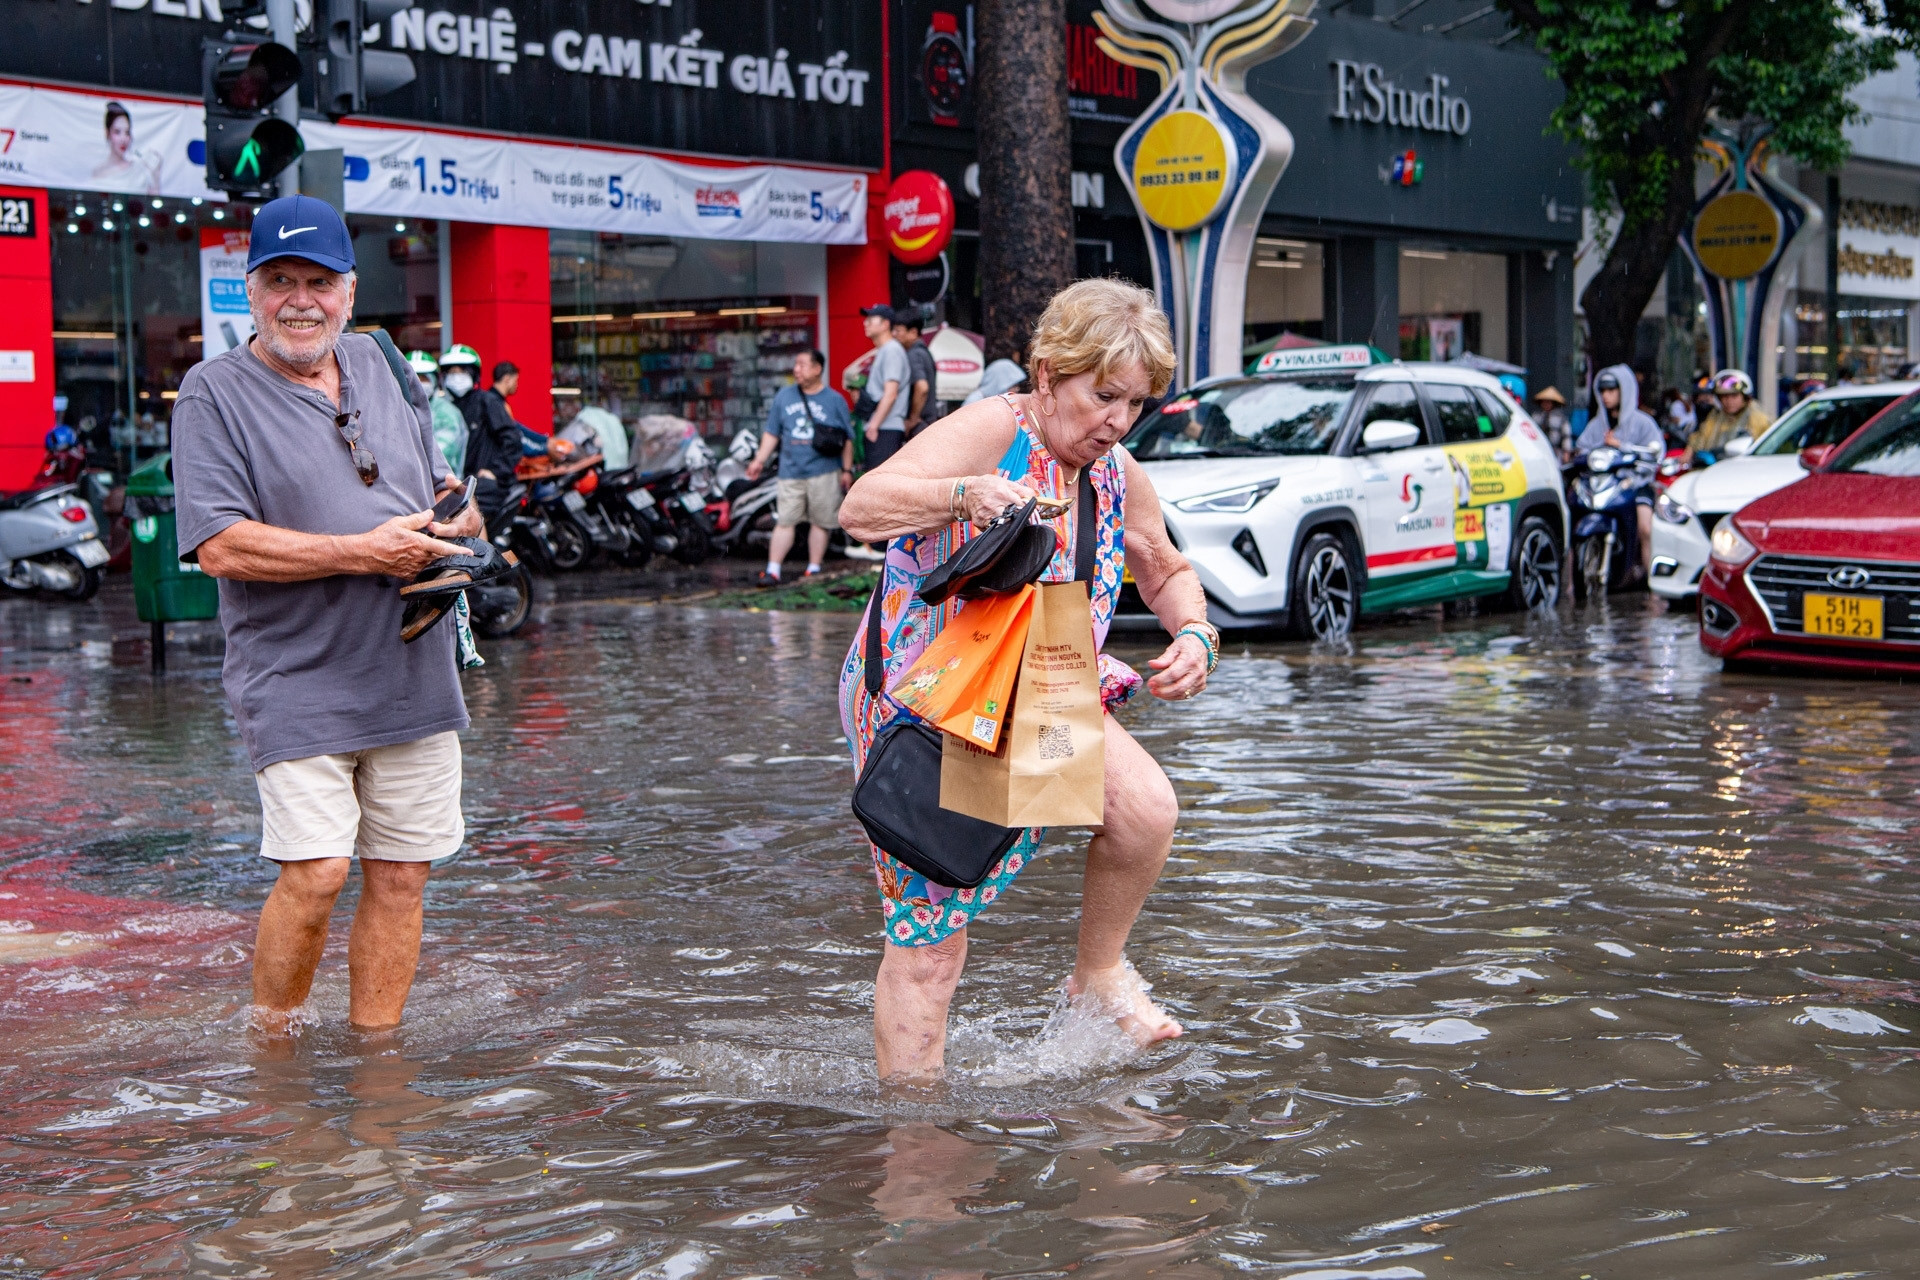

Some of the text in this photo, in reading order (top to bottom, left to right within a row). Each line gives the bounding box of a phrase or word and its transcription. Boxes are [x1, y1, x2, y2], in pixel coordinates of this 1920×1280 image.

[391, 8, 517, 75] NGHỆ
[551, 29, 643, 79] CAM
[650, 28, 724, 88] KẾT
[730, 48, 796, 98] GIÁ
[799, 50, 870, 107] TỐT
[414, 156, 500, 204] 1.5 Triệu
[533, 168, 551, 185] Thu
[608, 175, 662, 217] 5 Triệu
[811, 191, 824, 222] 5
[0, 199, 29, 223] 21
[1826, 598, 1860, 617] 51H
[1815, 615, 1874, 636] 119.23
